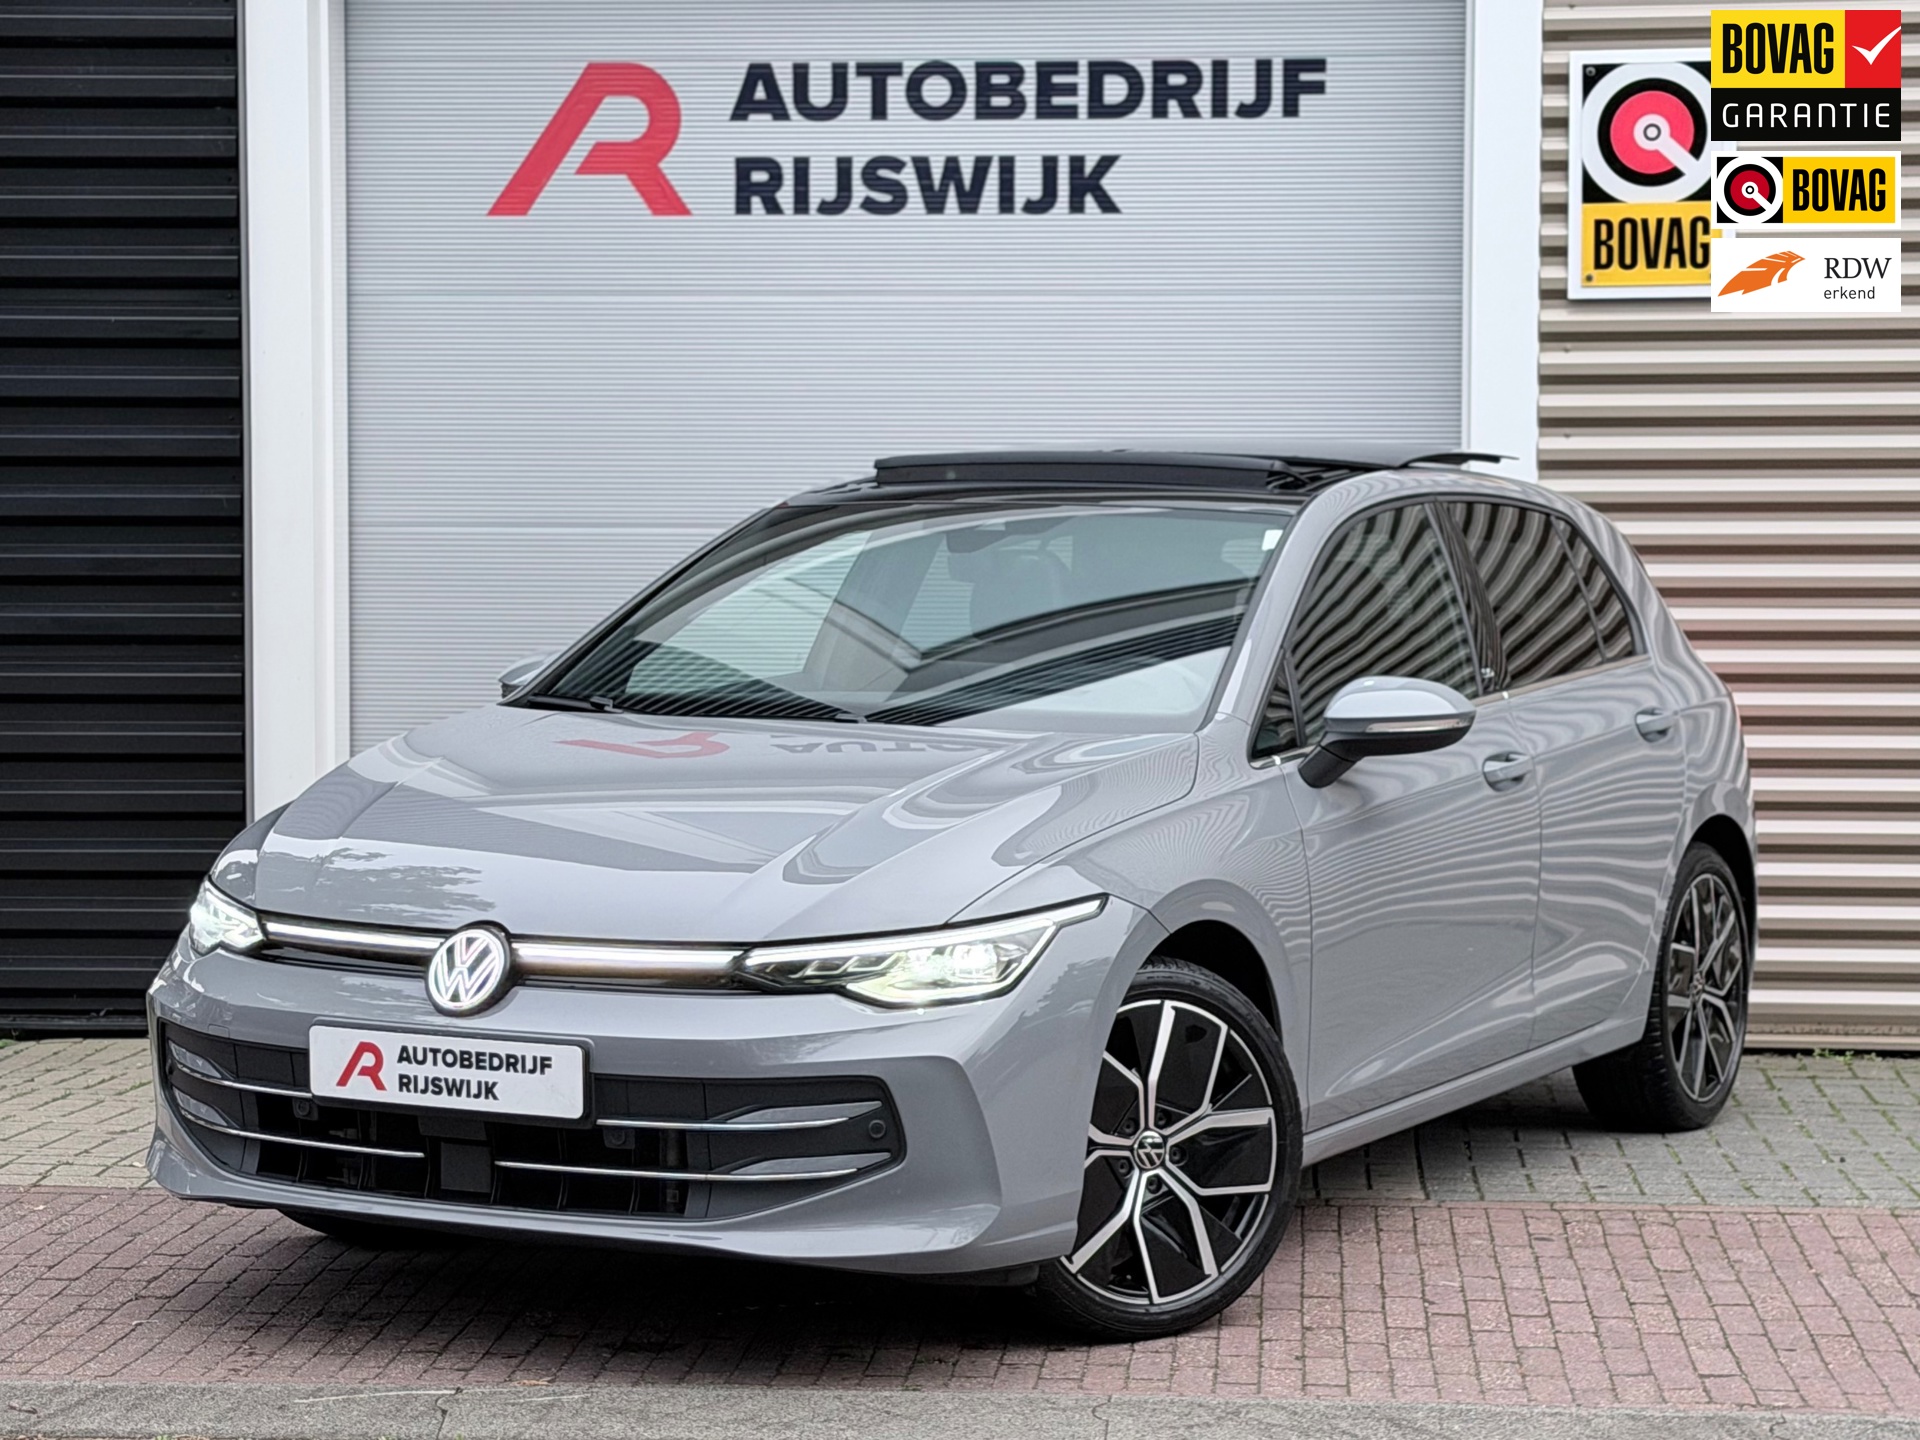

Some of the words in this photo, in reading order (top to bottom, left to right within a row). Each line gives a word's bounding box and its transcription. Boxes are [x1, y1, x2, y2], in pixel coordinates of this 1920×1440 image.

[730, 58, 1328, 122] AUTOBEDRIJF
[734, 155, 1122, 216] RIJSWIJK
[1593, 215, 1710, 271] BOVAG
[397, 1044, 553, 1076] AUTOBEDRIJF
[397, 1072, 499, 1101] RIJSWIJK
